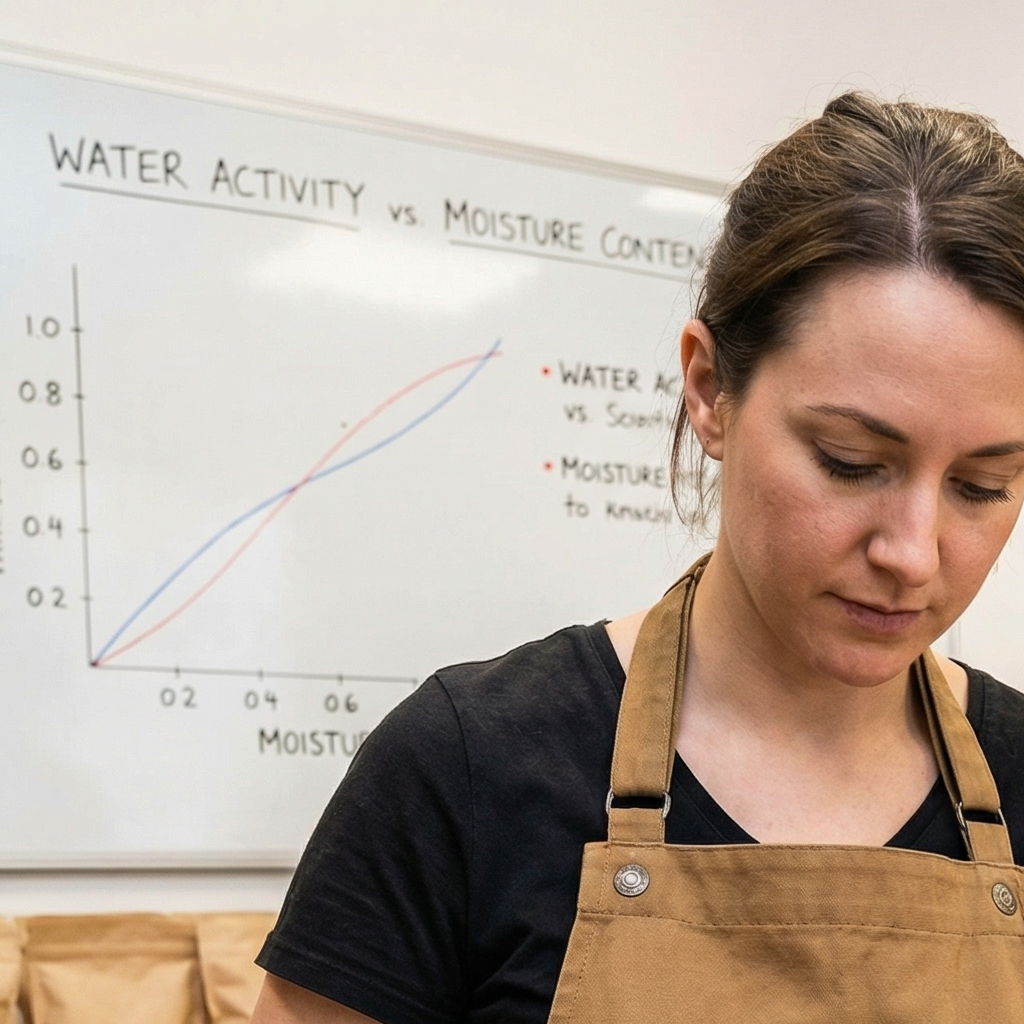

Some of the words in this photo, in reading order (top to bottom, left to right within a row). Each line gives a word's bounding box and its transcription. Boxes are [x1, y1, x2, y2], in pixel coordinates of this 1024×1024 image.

[48, 132, 188, 190] WATER
[210, 158, 366, 217] ACTIVITY
[444, 198, 585, 252] MOISTURE
[559, 361, 641, 393] WATER
[561, 456, 667, 488] MOISTURE
[564, 494, 590, 518] to
